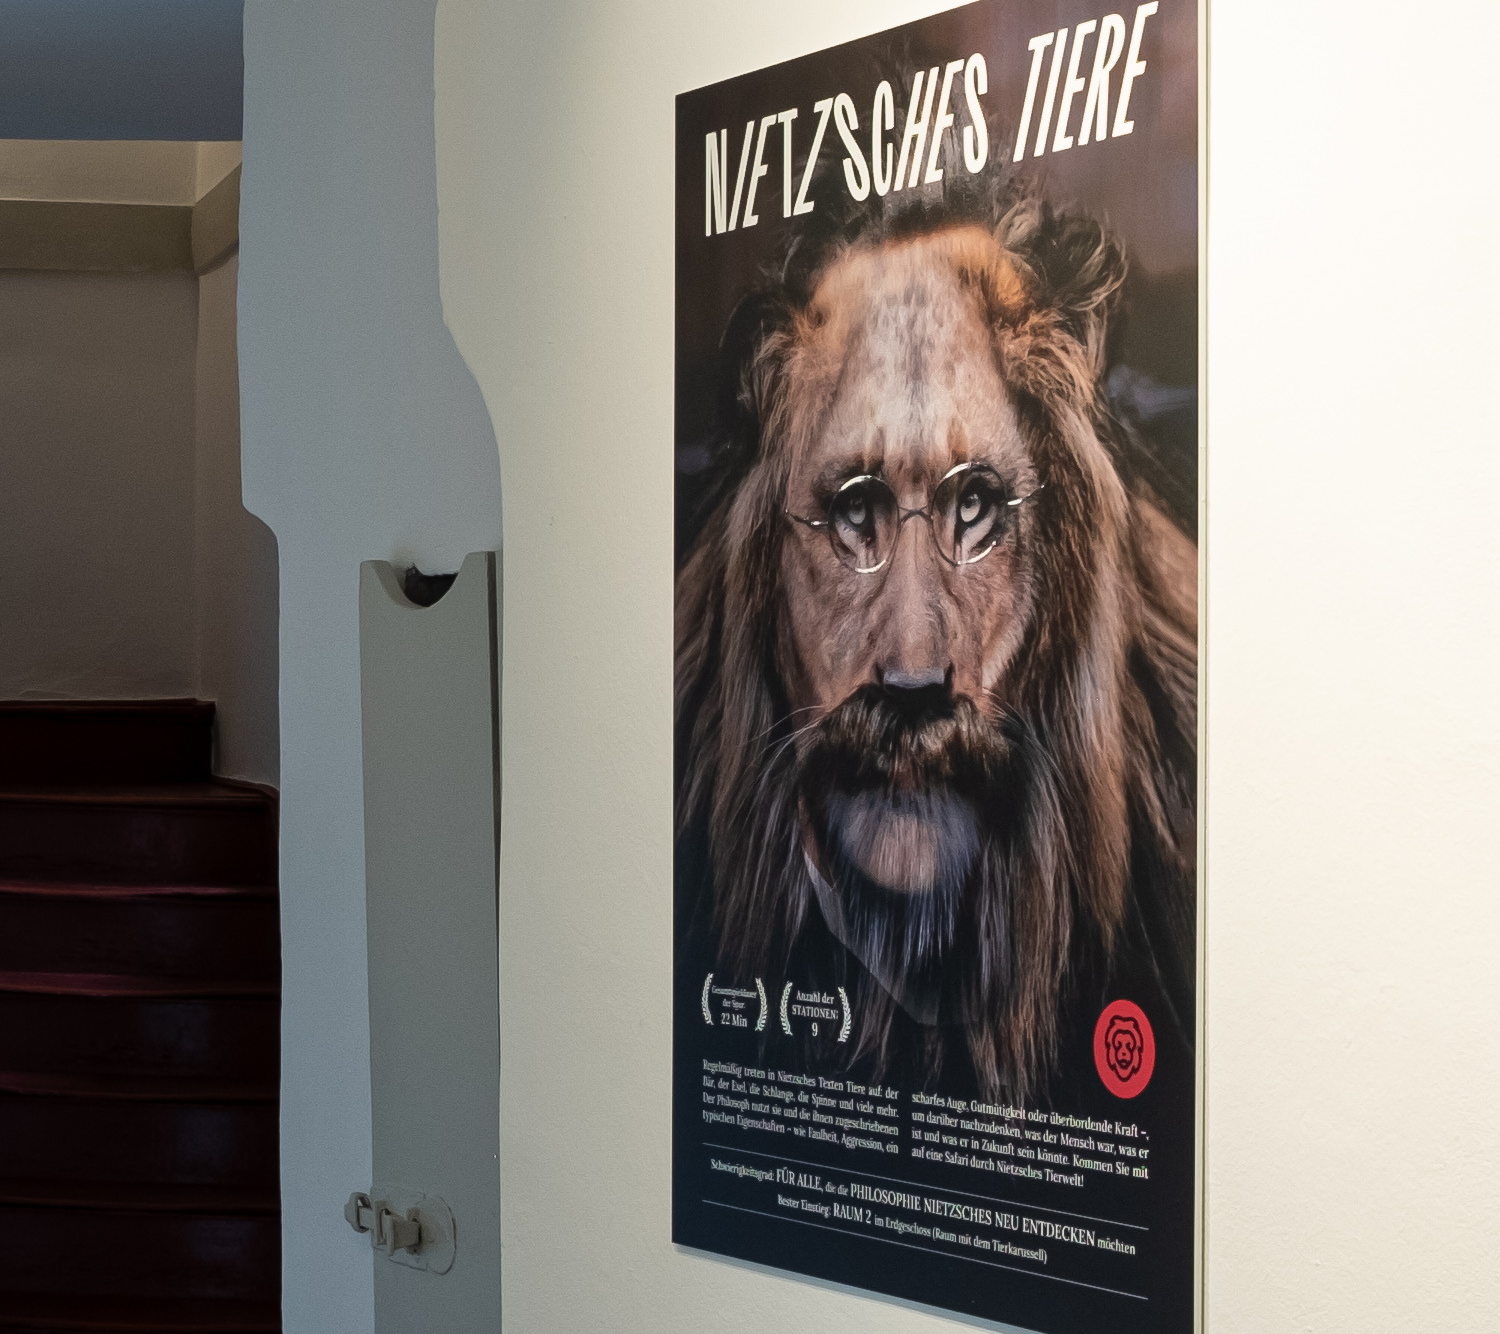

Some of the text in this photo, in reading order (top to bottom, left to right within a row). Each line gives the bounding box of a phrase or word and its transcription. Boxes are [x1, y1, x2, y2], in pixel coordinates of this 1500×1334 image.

[705, 1, 1159, 237] NIETZSCHES TIERE
[796, 989, 821, 1003] Anzahl
[720, 1012, 748, 1028] 22 Min
[811, 1022, 818, 1037] 9
[776, 1166, 795, 1186] FÜR
[796, 1172, 824, 1192] ALLE,
[850, 1182, 921, 1211] PHILOSOPHIE
[923, 1197, 992, 1226] NIETZSCHES
[994, 1211, 1019, 1231] NEU
[1022, 1217, 1096, 1247] ENTDECKEN
[1097, 1237, 1136, 1255] möchten
[833, 1202, 863, 1223] RAUM
[864, 1209, 872, 1225] 2
[885, 1216, 931, 1237] Erdgeschoss
[931, 1226, 957, 1243] (Raum
[972, 1235, 991, 1250] dem
[991, 1238, 1048, 1265] Tierkarussell)
